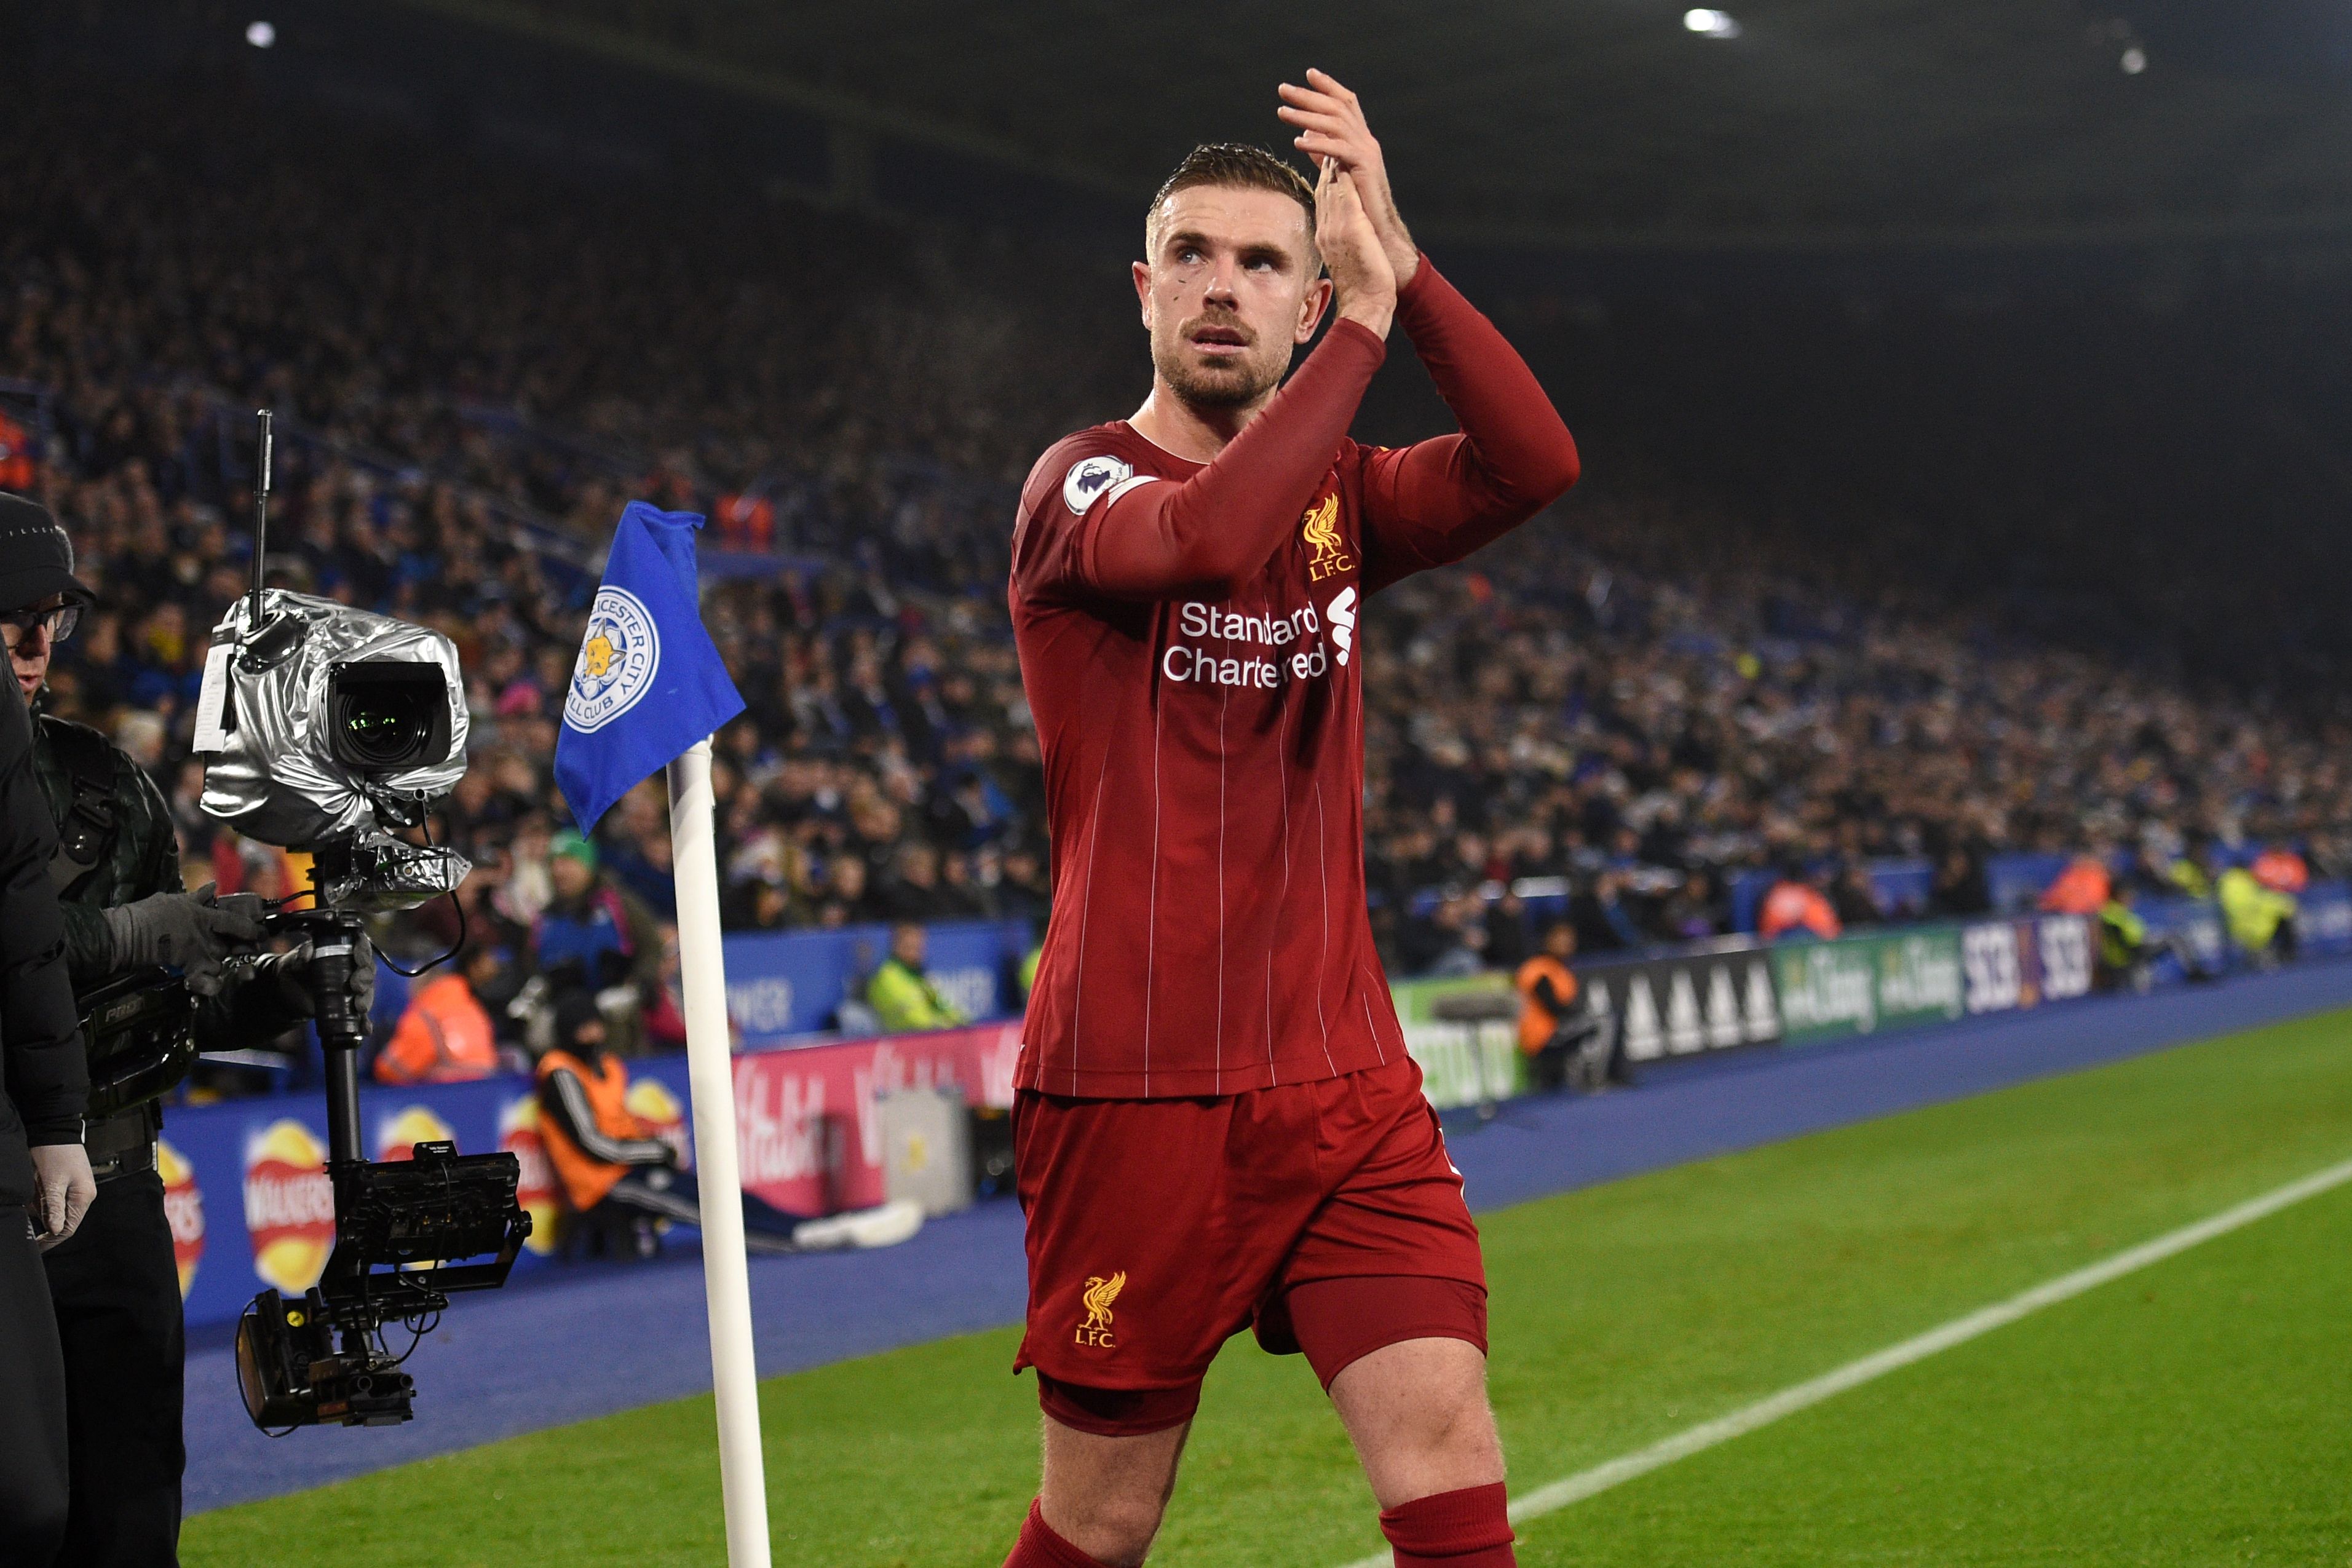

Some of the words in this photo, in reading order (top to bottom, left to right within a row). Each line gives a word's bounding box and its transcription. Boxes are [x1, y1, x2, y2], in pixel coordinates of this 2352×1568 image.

[1310, 555, 1356, 581] L.F.C.
[1180, 601, 1321, 645] Standard
[592, 600, 645, 647] ICESTER
[620, 652, 644, 695] CITY
[1163, 642, 1327, 689] Chartered
[584, 695, 614, 719] CLUB
[1074, 1329, 1116, 1348] L.F.C.
